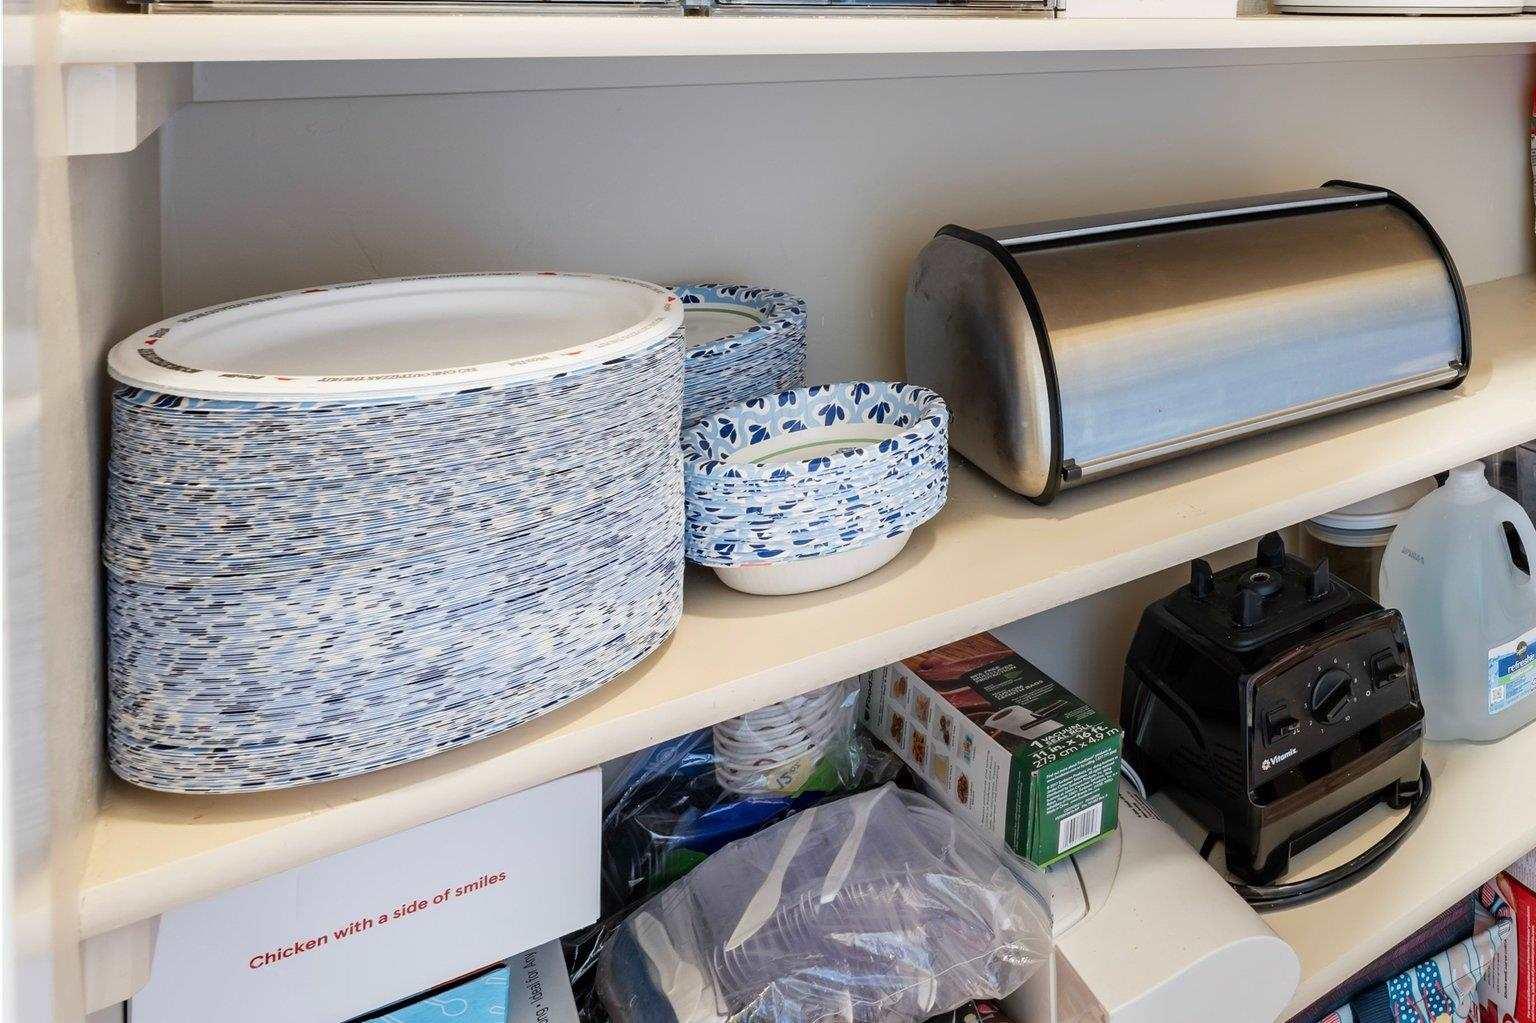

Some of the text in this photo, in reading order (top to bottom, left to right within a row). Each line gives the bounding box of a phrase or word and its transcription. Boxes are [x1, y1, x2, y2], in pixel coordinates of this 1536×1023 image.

[1032, 750, 1048, 760] 11
[1048, 742, 1066, 753] in.
[1076, 730, 1092, 741] 16
[1091, 724, 1108, 734] ft.
[1032, 753, 1057, 769] 27.9
[1059, 745, 1079, 758] cm
[1088, 733, 1105, 745] 4.9
[1106, 727, 1120, 737] m
[1269, 747, 1299, 766] Vitamix
[248, 870, 508, 971] Chicken with a side of smiles
